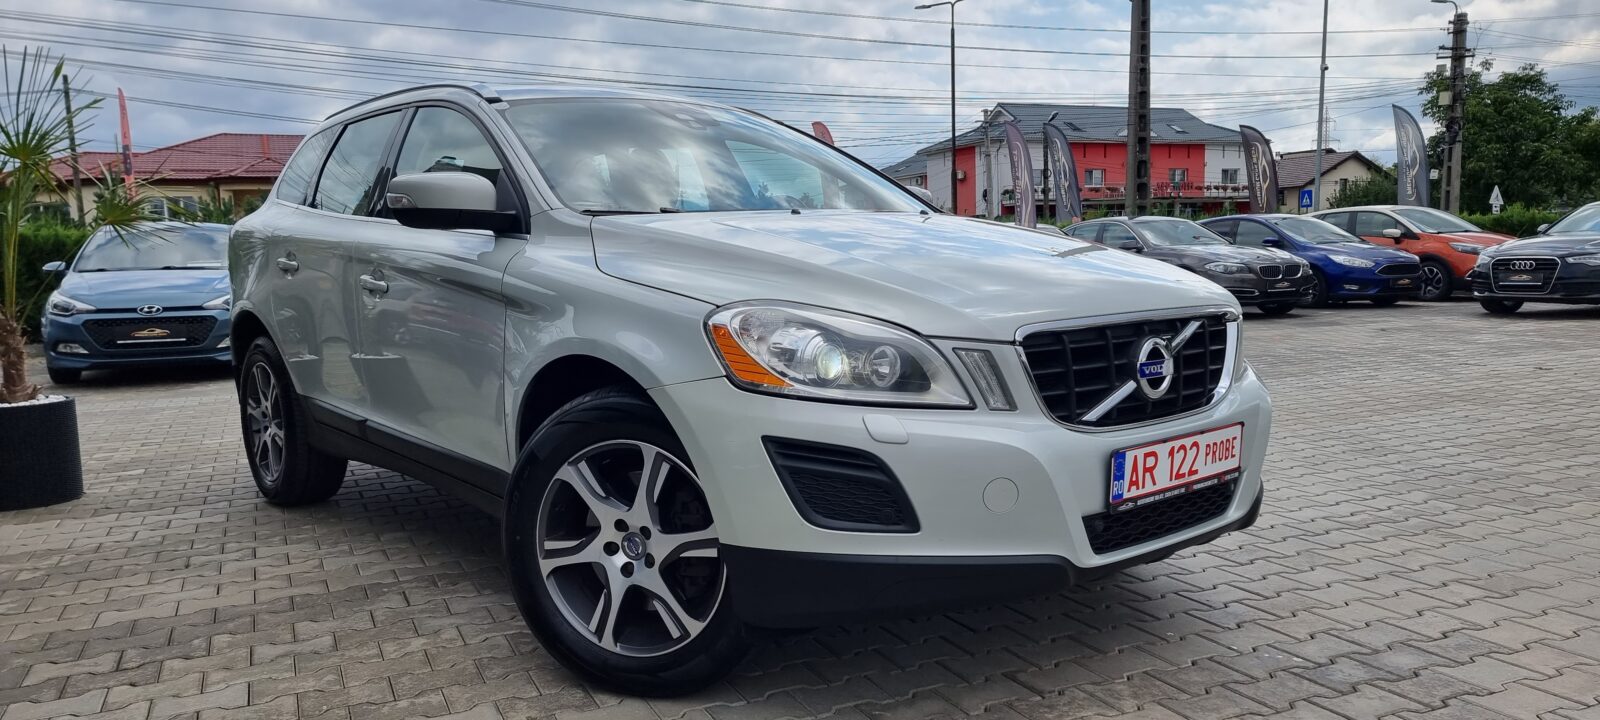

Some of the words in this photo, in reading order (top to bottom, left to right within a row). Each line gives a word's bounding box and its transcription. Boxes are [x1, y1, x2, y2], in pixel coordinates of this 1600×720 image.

[1142, 363, 1166, 375] VOL
[1127, 451, 1159, 493] AR
[1168, 440, 1201, 482] 122
[1204, 436, 1238, 466] PROBE
[1113, 481, 1124, 496] RO
